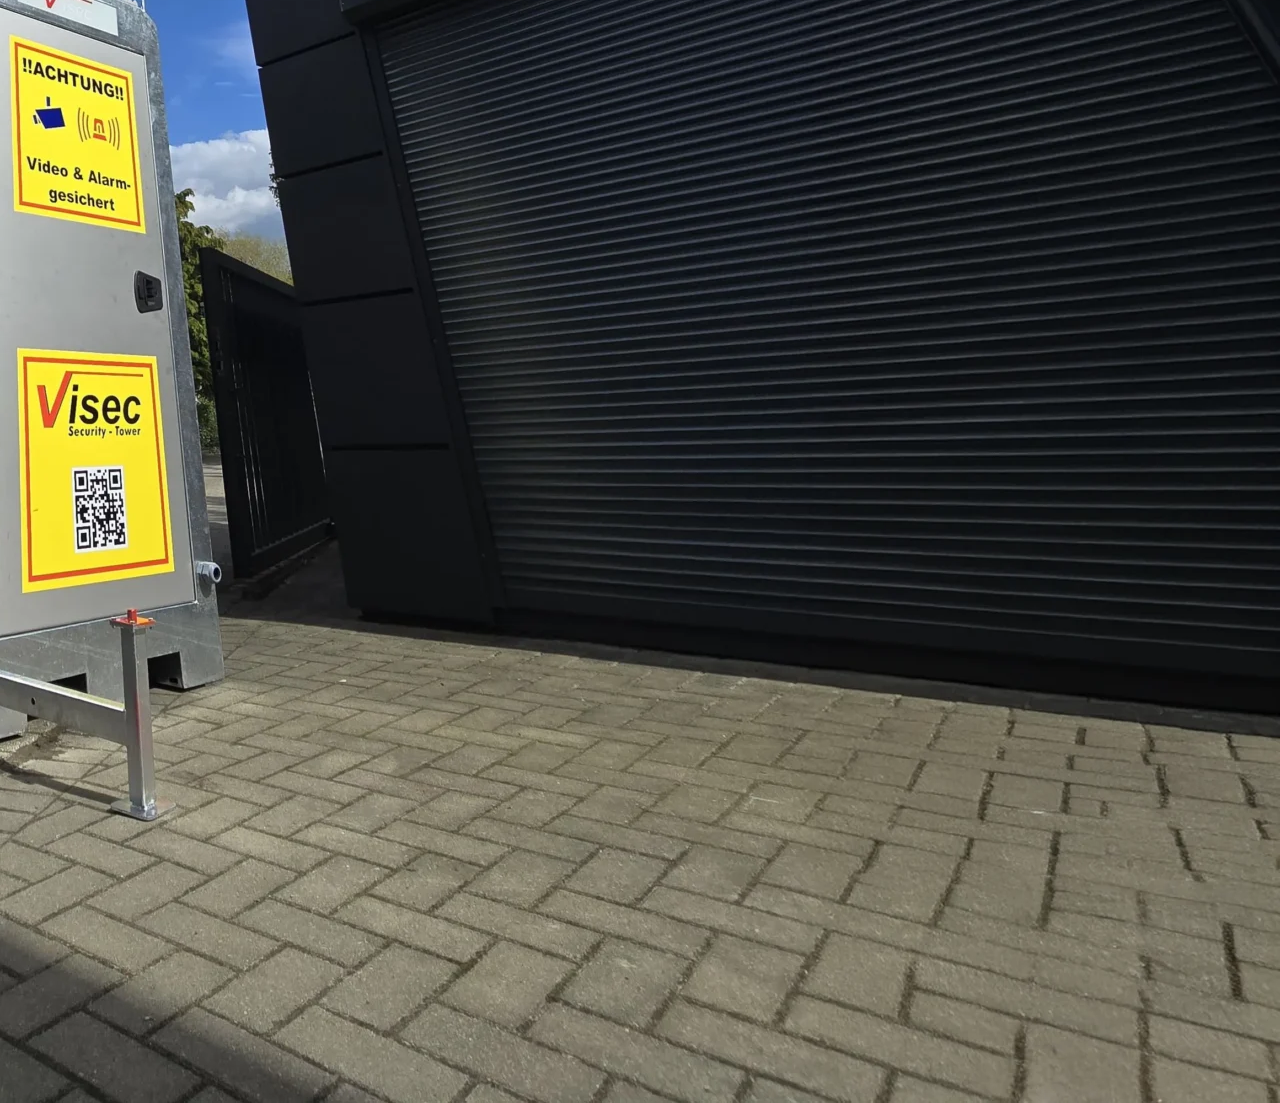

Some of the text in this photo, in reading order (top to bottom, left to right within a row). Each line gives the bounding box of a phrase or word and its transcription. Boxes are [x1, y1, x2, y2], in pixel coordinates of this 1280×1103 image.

[22, 57, 124, 101] !!ACHTUNG!!
[26, 156, 131, 190] Video & Alarm-
[49, 188, 115, 211] gesichert
[37, 371, 143, 428] Visec
[68, 425, 106, 439] Security
[115, 426, 141, 436] Tower
